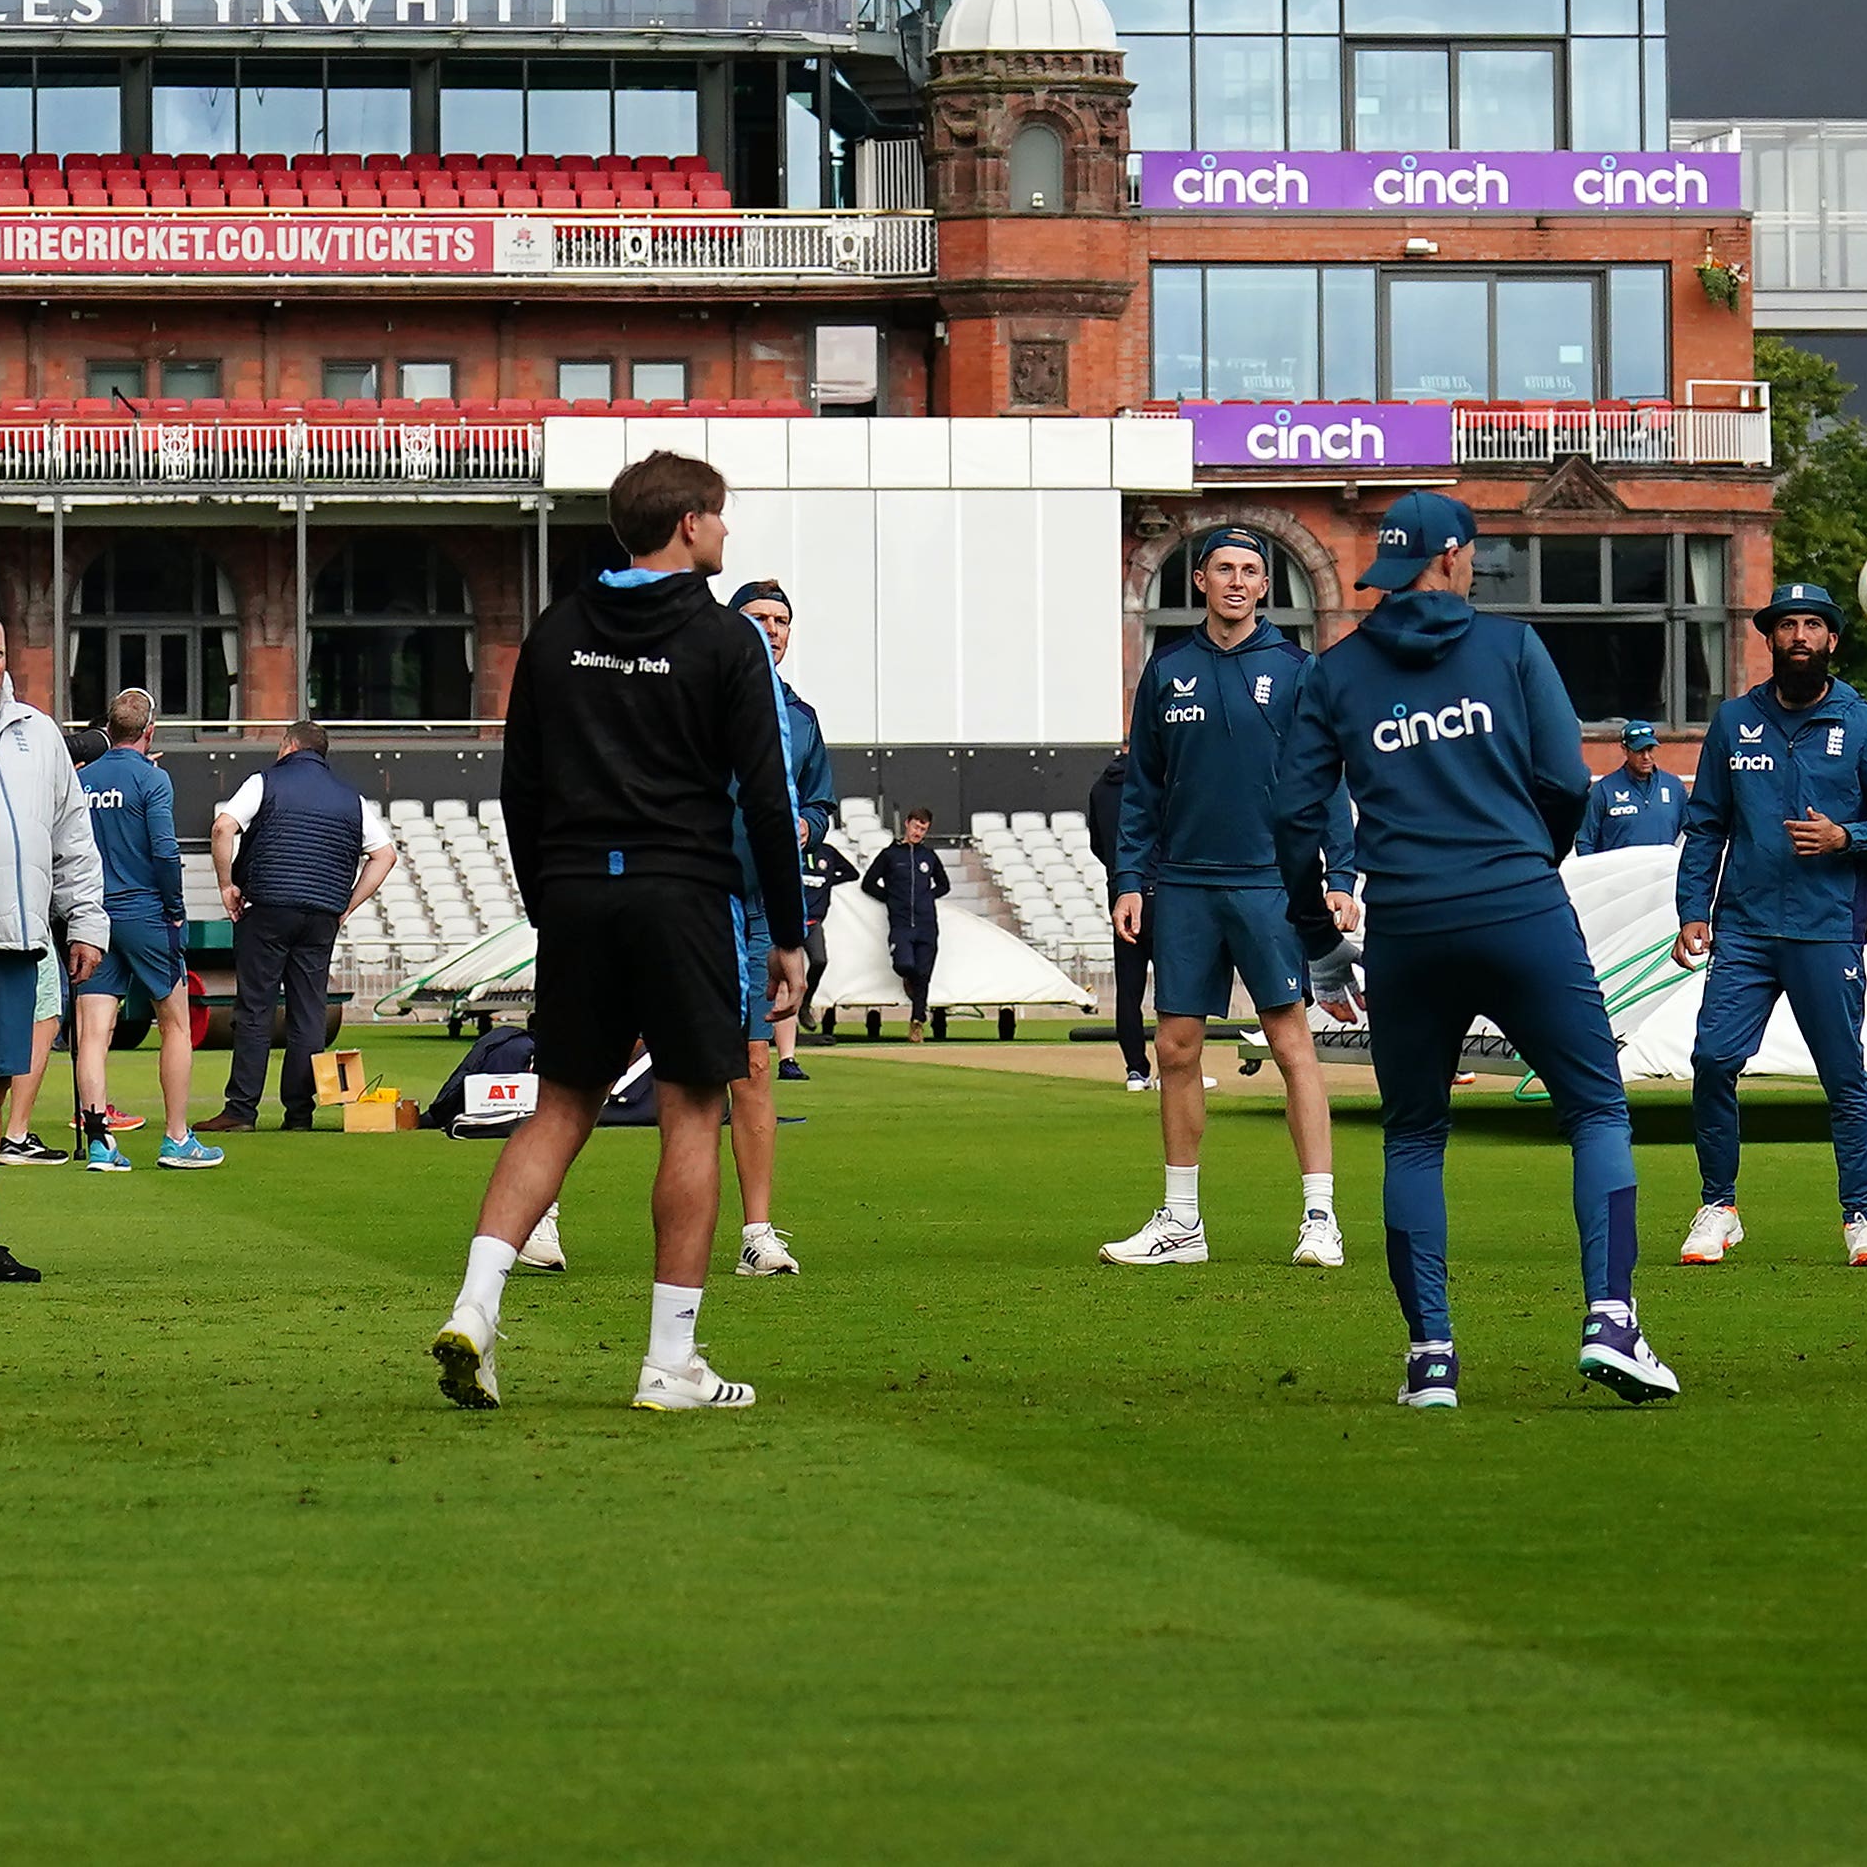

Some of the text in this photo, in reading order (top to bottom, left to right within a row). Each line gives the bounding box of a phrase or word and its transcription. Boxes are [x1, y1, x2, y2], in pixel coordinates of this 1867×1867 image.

[1173, 154, 1309, 205] cinch
[1373, 154, 1509, 205] cinch
[1572, 154, 1708, 205] cinch
[1247, 408, 1384, 461] cinch
[570, 650, 671, 675] Jointing Tech
[1165, 703, 1205, 724] cinch
[1373, 698, 1493, 753] cinch
[1729, 750, 1774, 771] cinch
[83, 784, 124, 809] inch
[487, 1084, 520, 1100] AT
